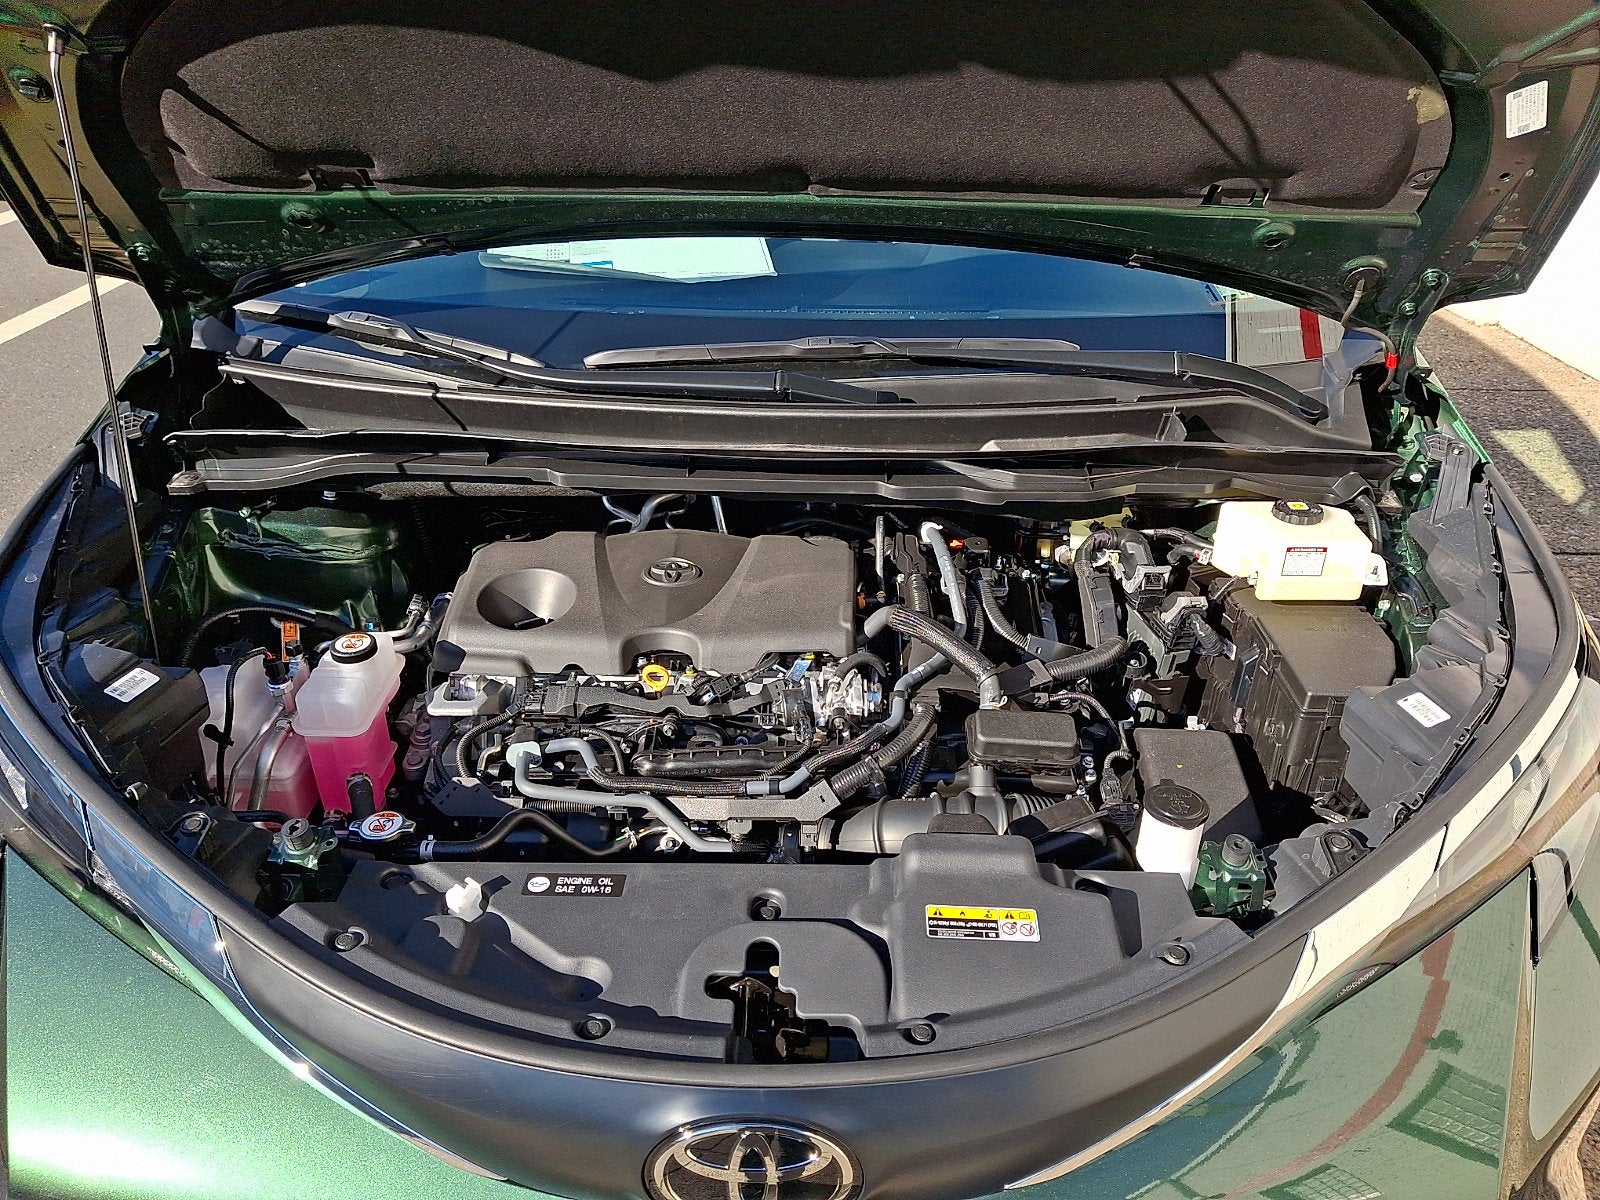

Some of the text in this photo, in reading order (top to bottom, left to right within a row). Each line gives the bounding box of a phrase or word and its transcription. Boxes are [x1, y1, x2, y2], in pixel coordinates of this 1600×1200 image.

[557, 876, 614, 885] ENGINE OIL
[555, 885, 611, 894] SAE 0W-16
